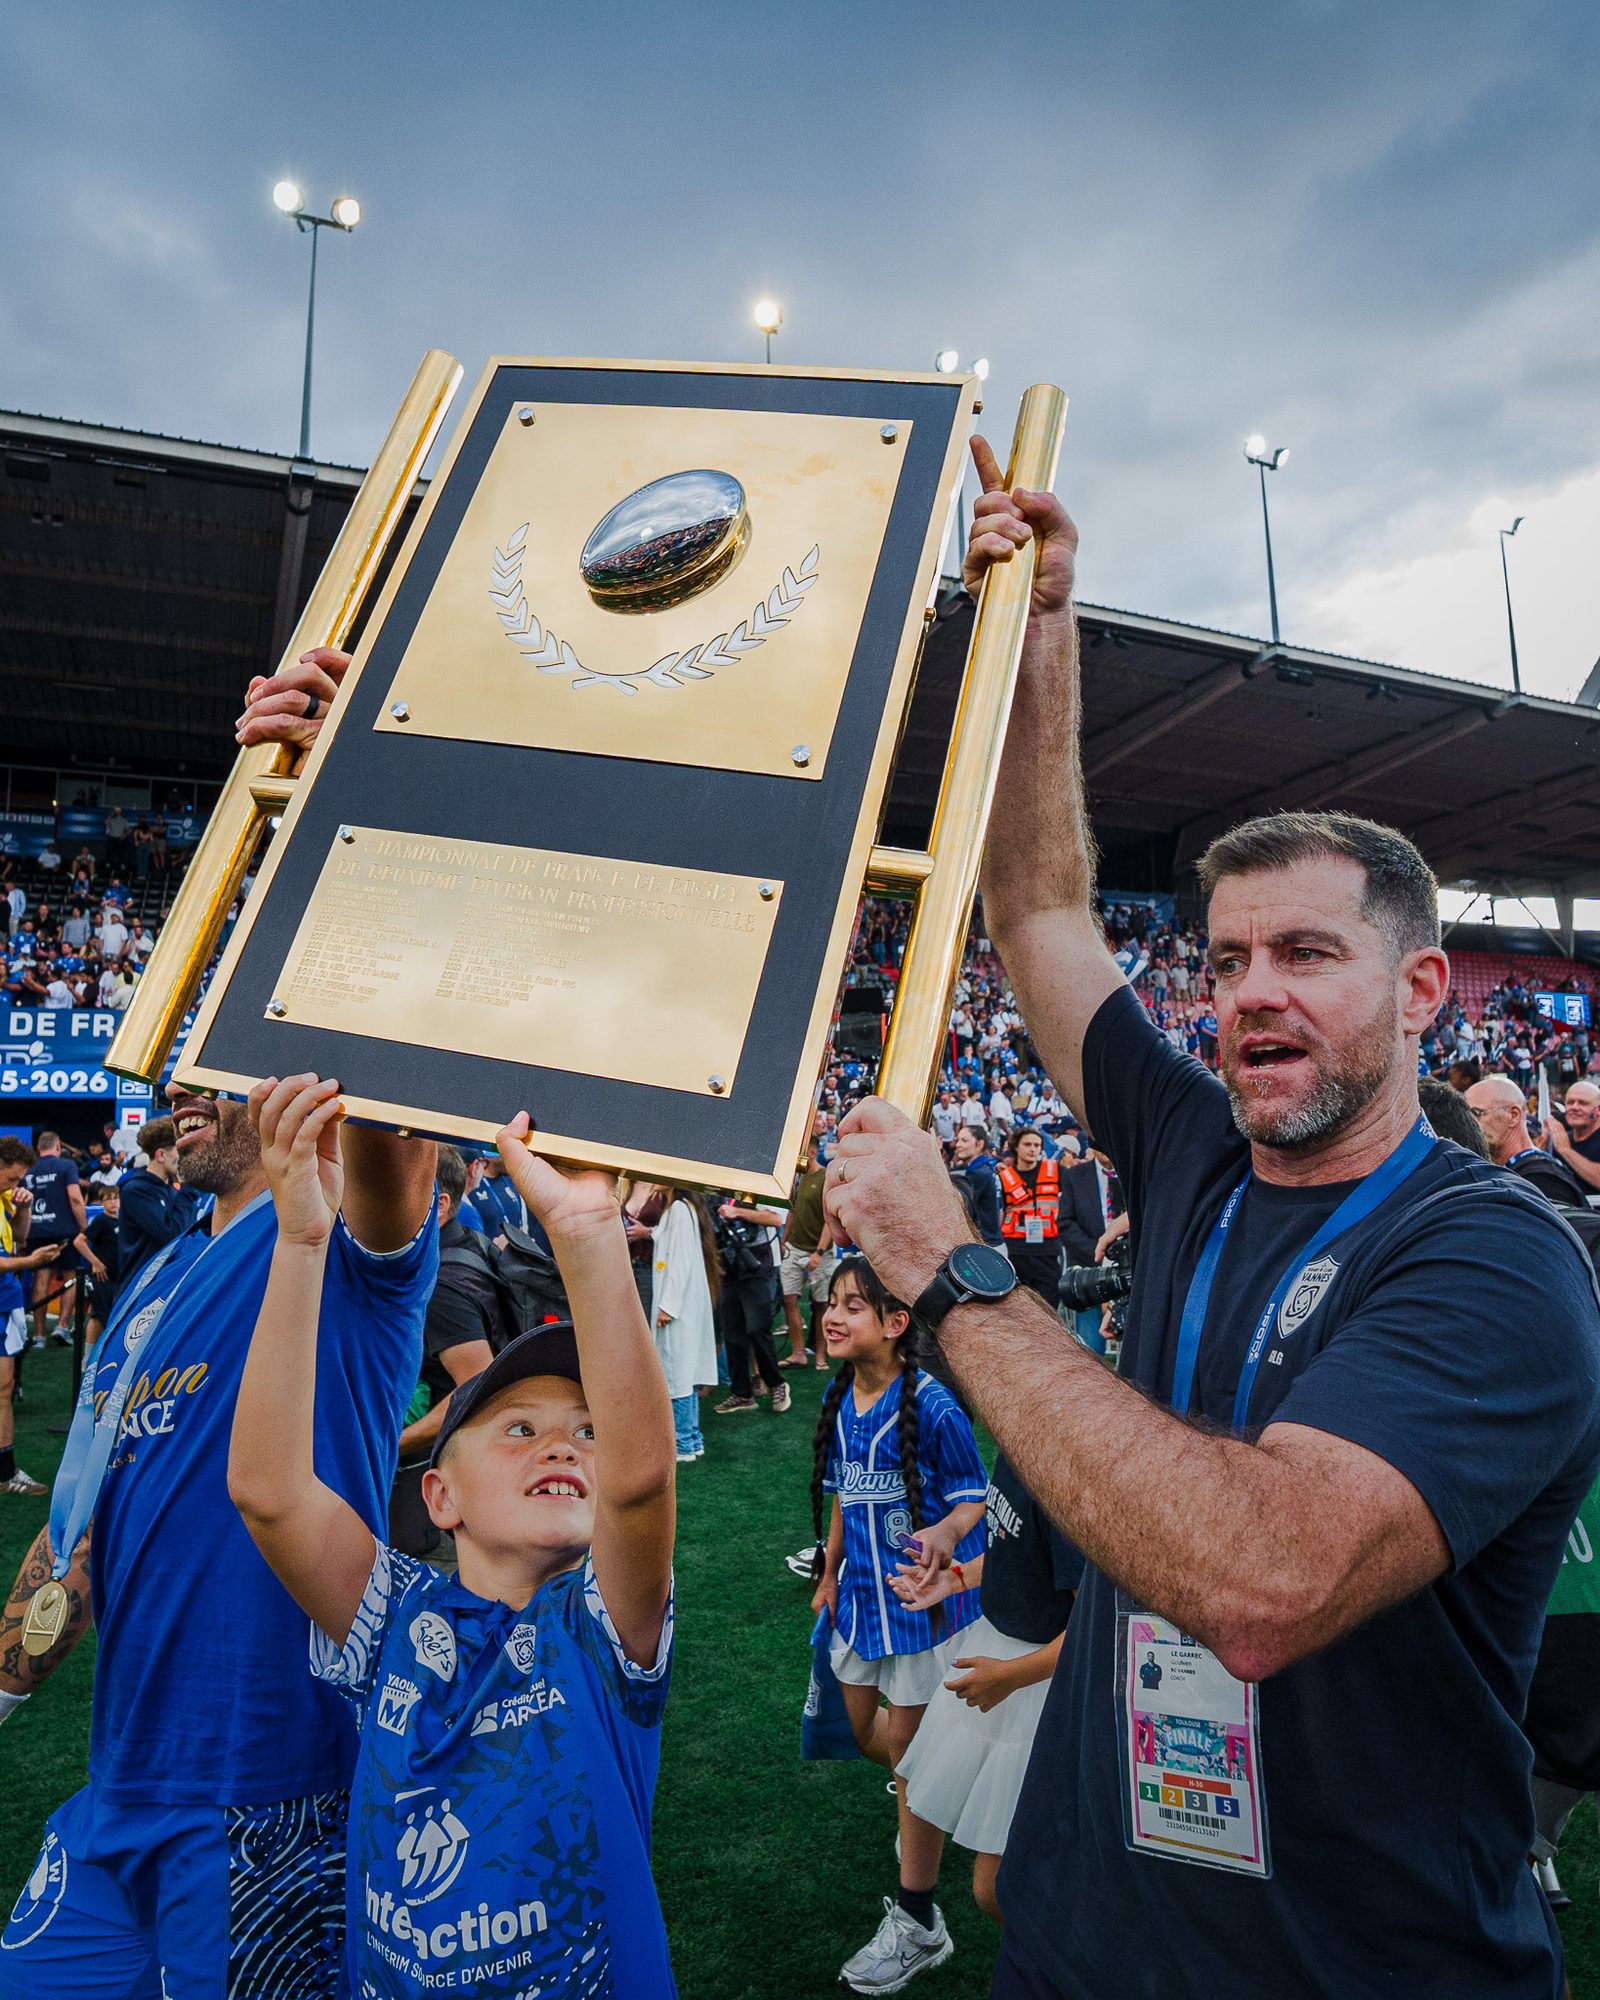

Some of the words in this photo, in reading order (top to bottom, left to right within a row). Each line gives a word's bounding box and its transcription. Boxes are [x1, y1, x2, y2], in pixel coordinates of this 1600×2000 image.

[333, 857, 363, 878] DE
[467, 875, 561, 906] DIVISION
[361, 836, 504, 871] CHAMPIONNAT
[506, 855, 538, 876] DE
[540, 859, 626, 887] FRANCE
[631, 871, 663, 892] DE
[665, 876, 741, 903] RUGBY
[9, 1012, 56, 1037] DE
[1301, 1272, 1333, 1283] VANNES
[842, 1461, 908, 1493] Vann
[884, 1508, 913, 1549] 8
[1170, 1650, 1177, 1658] LE
[1179, 1651, 1203, 1660] GARREC
[1165, 1727, 1213, 1754] FINALE
[1146, 1785, 1154, 1799] 1
[1167, 1789, 1176, 1803] 2
[1192, 1794, 1200, 1808] 3
[1223, 1800, 1232, 1814] 5
[461, 1950, 532, 1985] D'AVENIR
